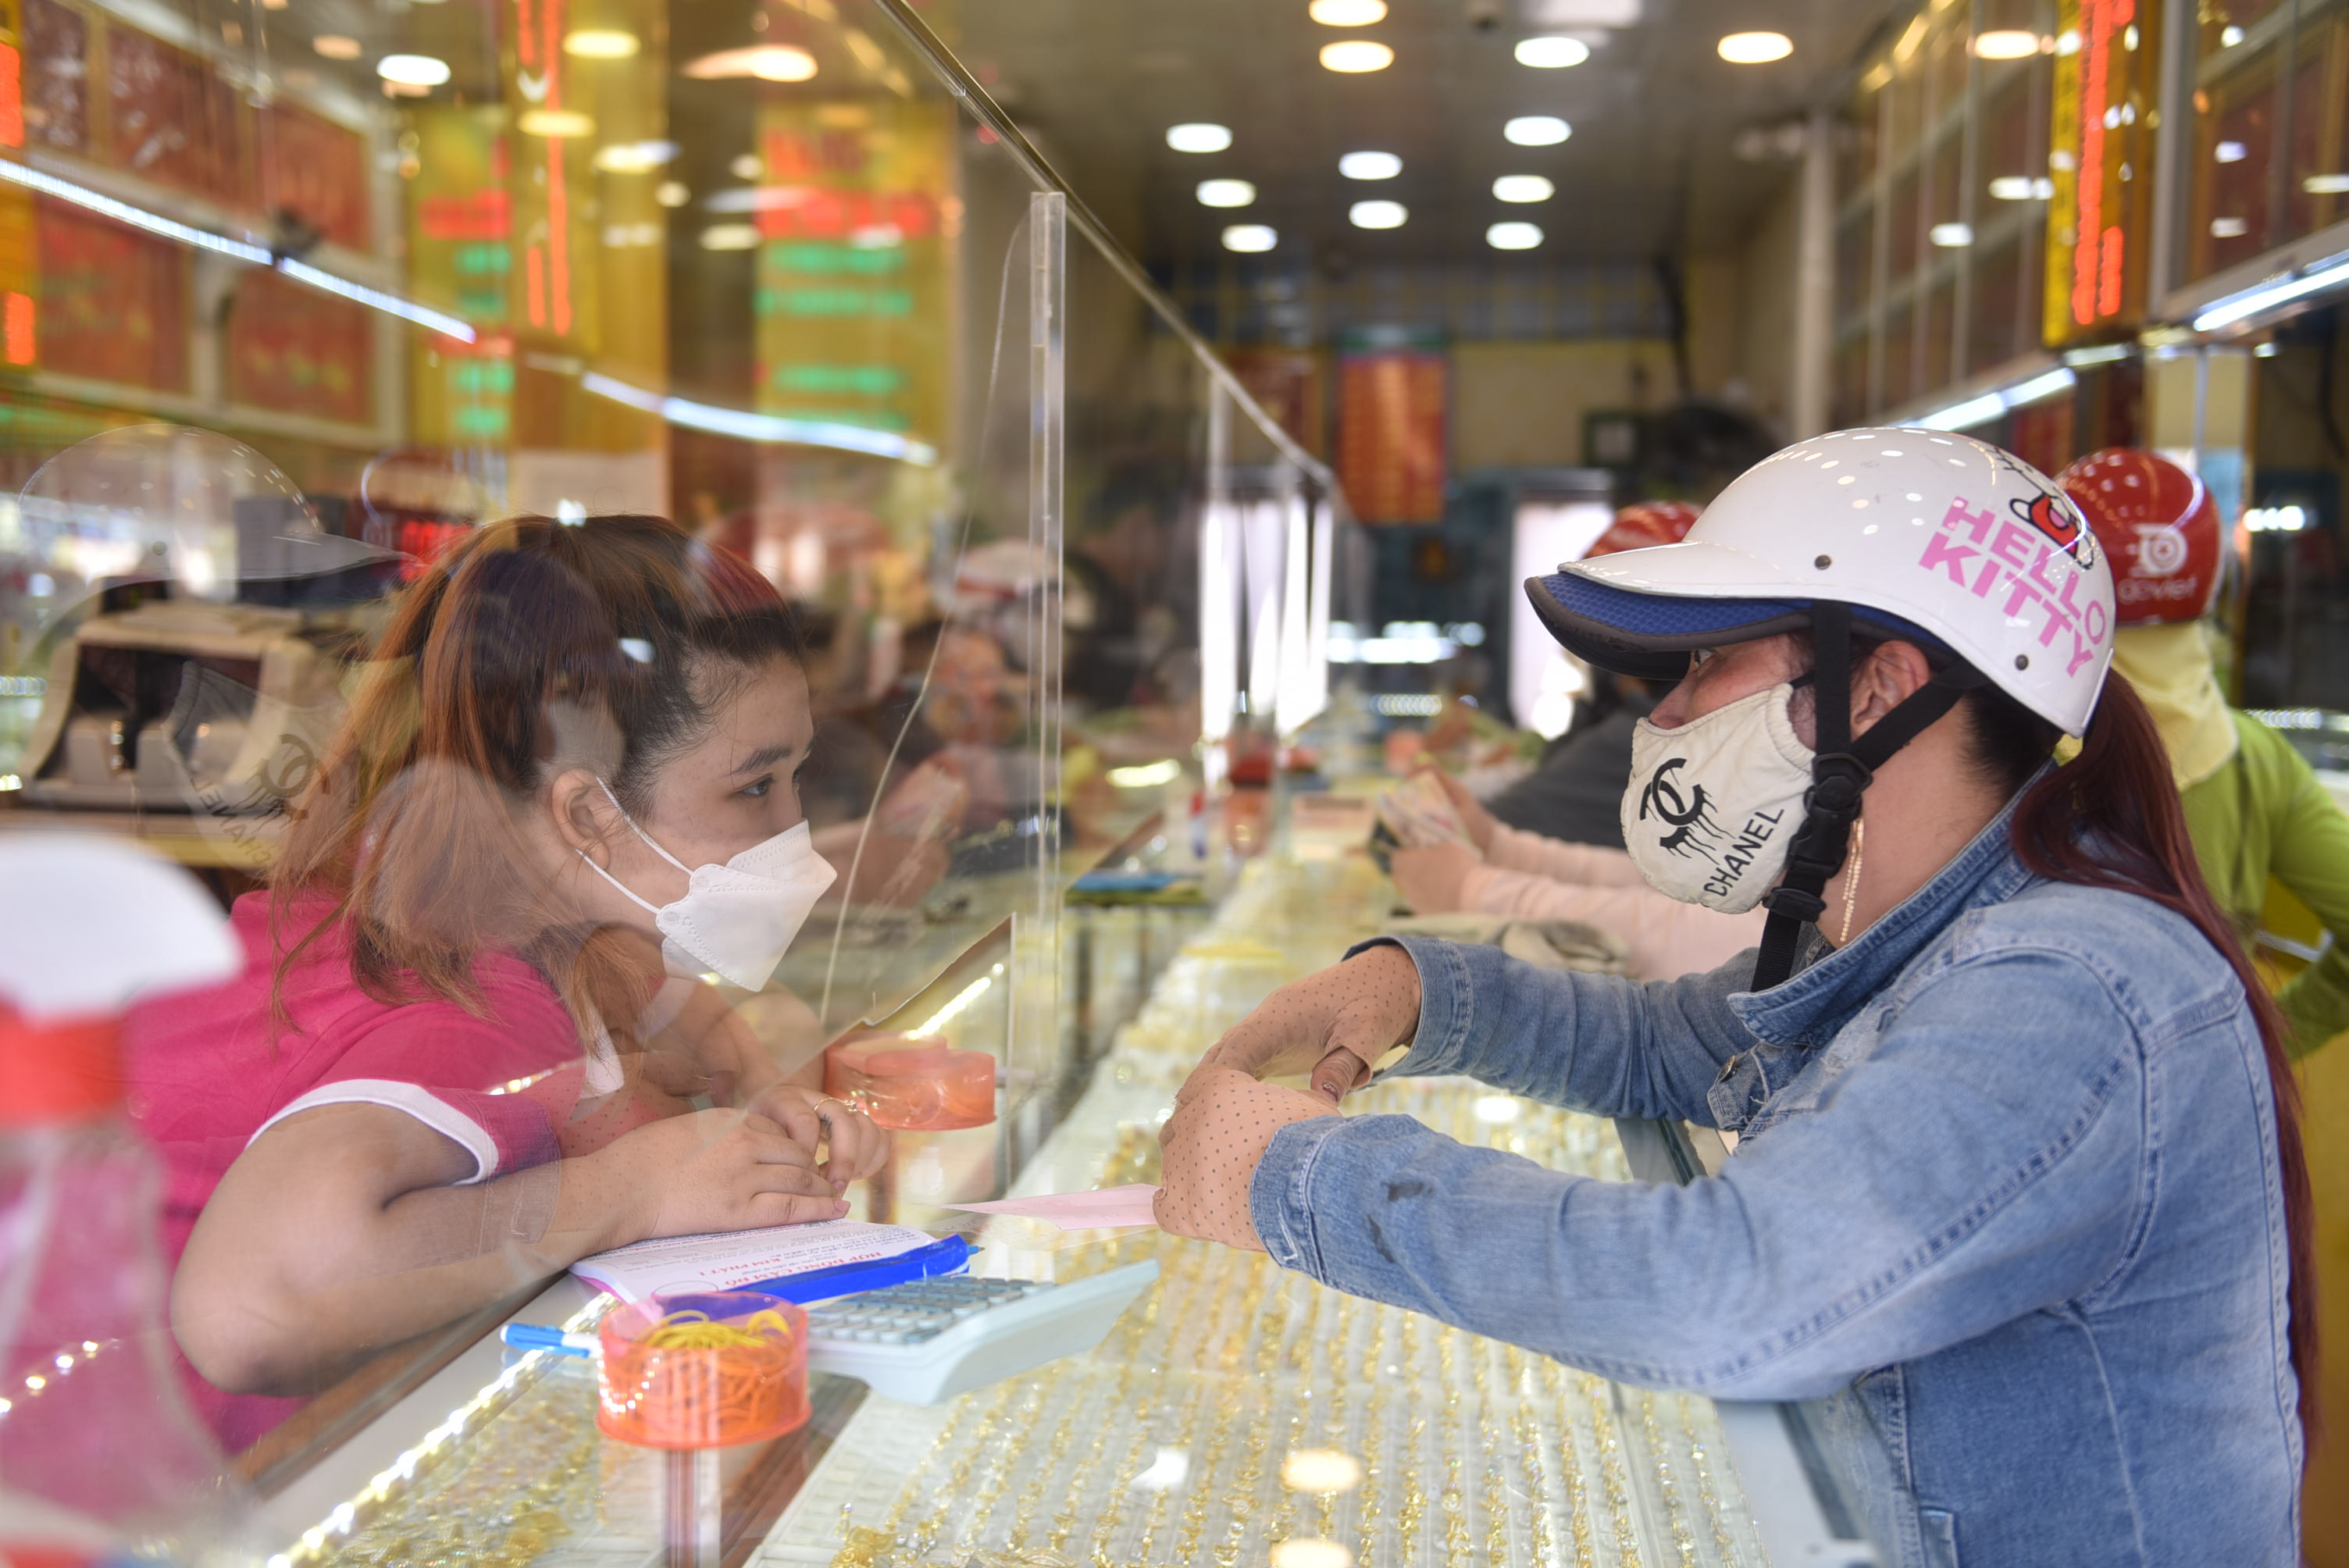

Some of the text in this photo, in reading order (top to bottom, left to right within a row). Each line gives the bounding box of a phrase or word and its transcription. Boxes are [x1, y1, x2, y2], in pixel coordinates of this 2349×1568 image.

[1919, 532, 2094, 678] KITTY
[1942, 496, 2106, 645] HELLO
[1703, 808, 1784, 897] CHANEL
